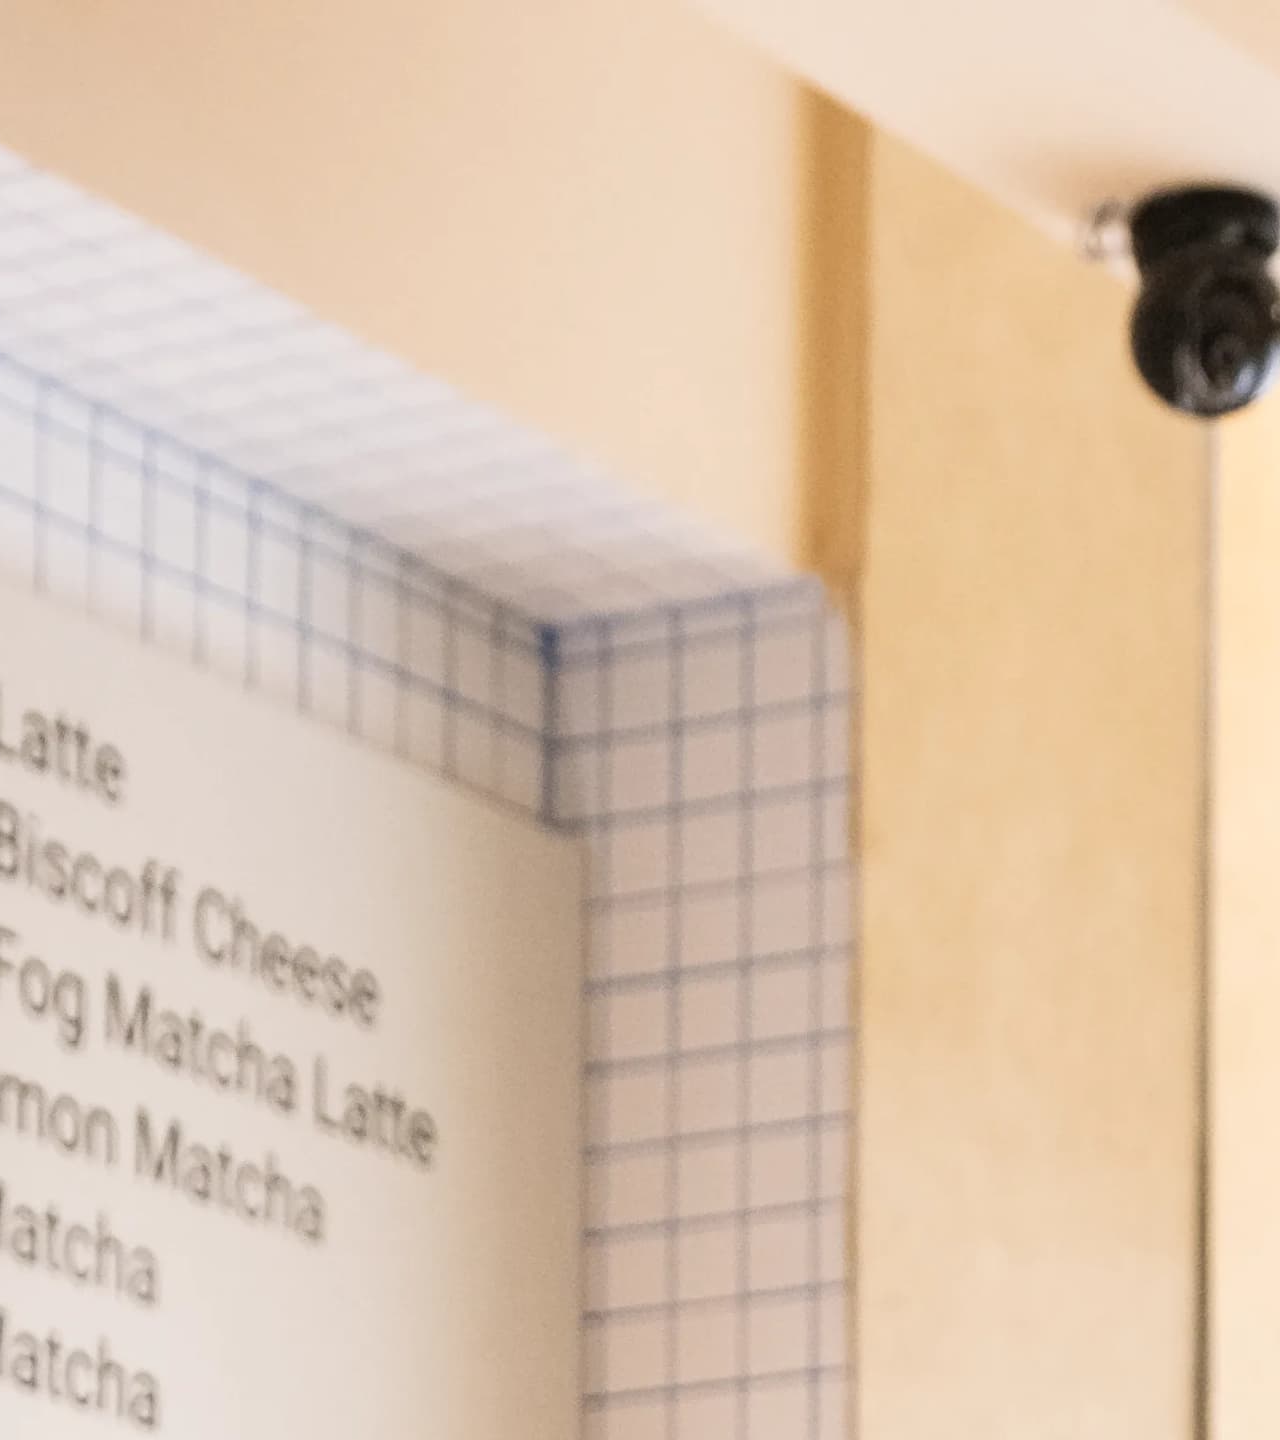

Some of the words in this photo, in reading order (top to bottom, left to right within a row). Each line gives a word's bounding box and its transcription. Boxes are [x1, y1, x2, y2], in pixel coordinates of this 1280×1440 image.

[195, 889, 379, 1026] Cheese
[106, 973, 296, 1114] Matcha
[315, 1059, 436, 1166] Latte
[136, 1108, 323, 1243] Matcha
